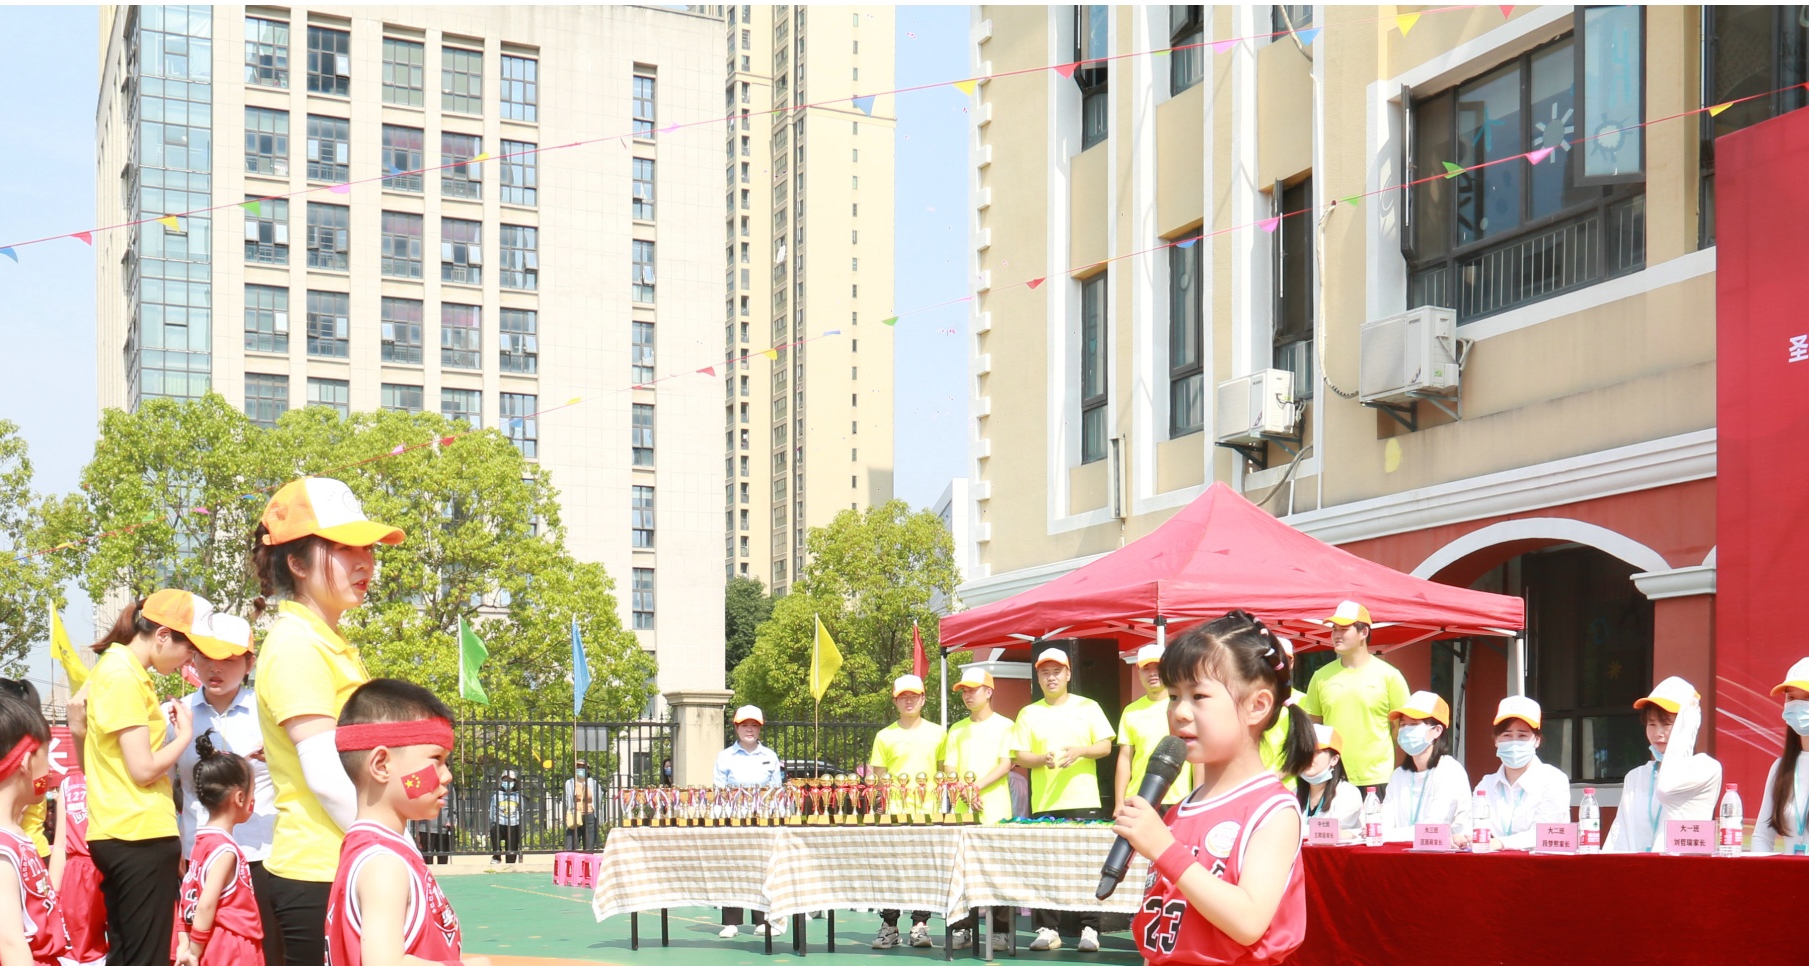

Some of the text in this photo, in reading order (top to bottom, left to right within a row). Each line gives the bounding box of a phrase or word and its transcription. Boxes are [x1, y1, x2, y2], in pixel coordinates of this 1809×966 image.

[1424, 826, 1439, 834] 大三班
[1548, 827, 1565, 835] 大二班
[1680, 825, 1700, 833] 大一班
[1142, 895, 1188, 955] 23
